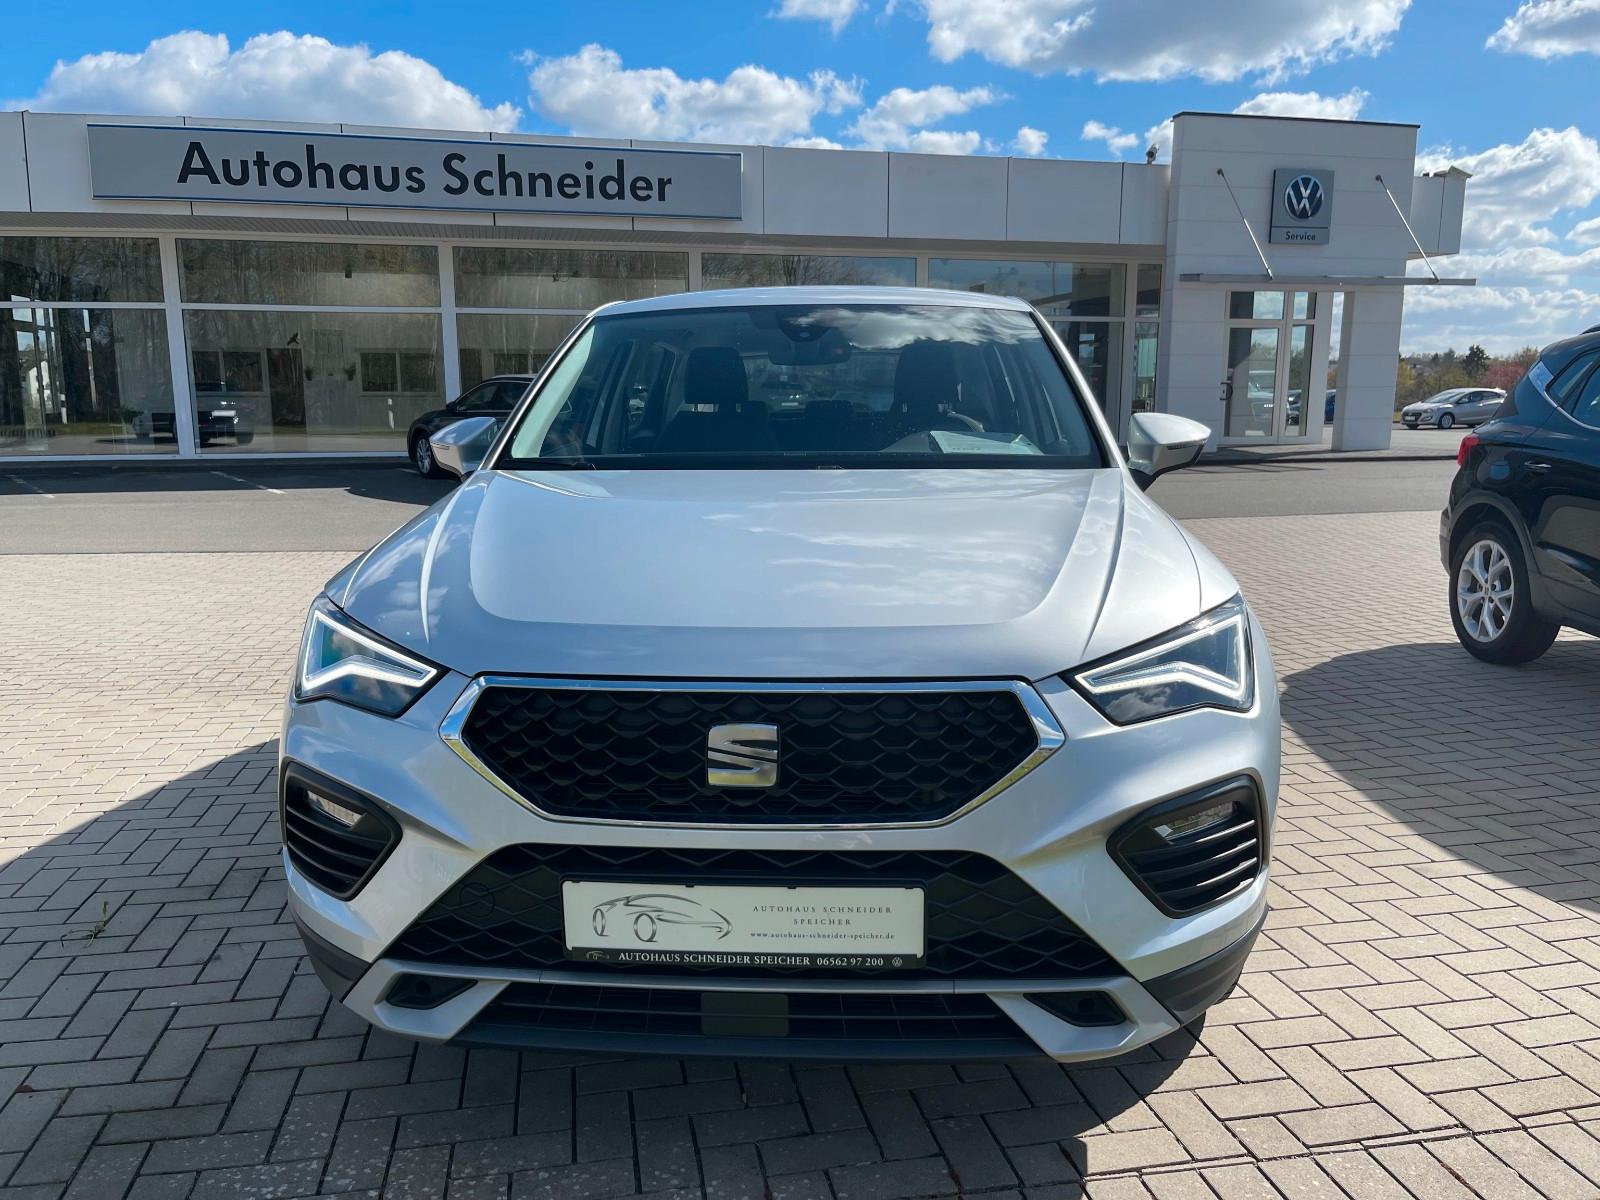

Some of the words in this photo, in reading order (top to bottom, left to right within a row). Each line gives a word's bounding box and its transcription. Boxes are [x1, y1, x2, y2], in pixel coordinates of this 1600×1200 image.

[177, 140, 426, 194] Autohaus
[442, 152, 673, 202] Schneider
[1285, 230, 1316, 241] Service
[753, 905, 816, 913] AUTOHAUS
[823, 906, 893, 914] SCHNEIDER
[793, 918, 852, 926] SPEICHER
[750, 932, 895, 940] www.autohaus-schneider-speicher.de
[618, 952, 680, 962] AUTOHAUS
[683, 953, 751, 964] SCHNEIDER
[754, 955, 810, 965] SPEICHER
[816, 957, 847, 966] 06562
[850, 957, 863, 966] 97
[865, 957, 884, 966] 200
